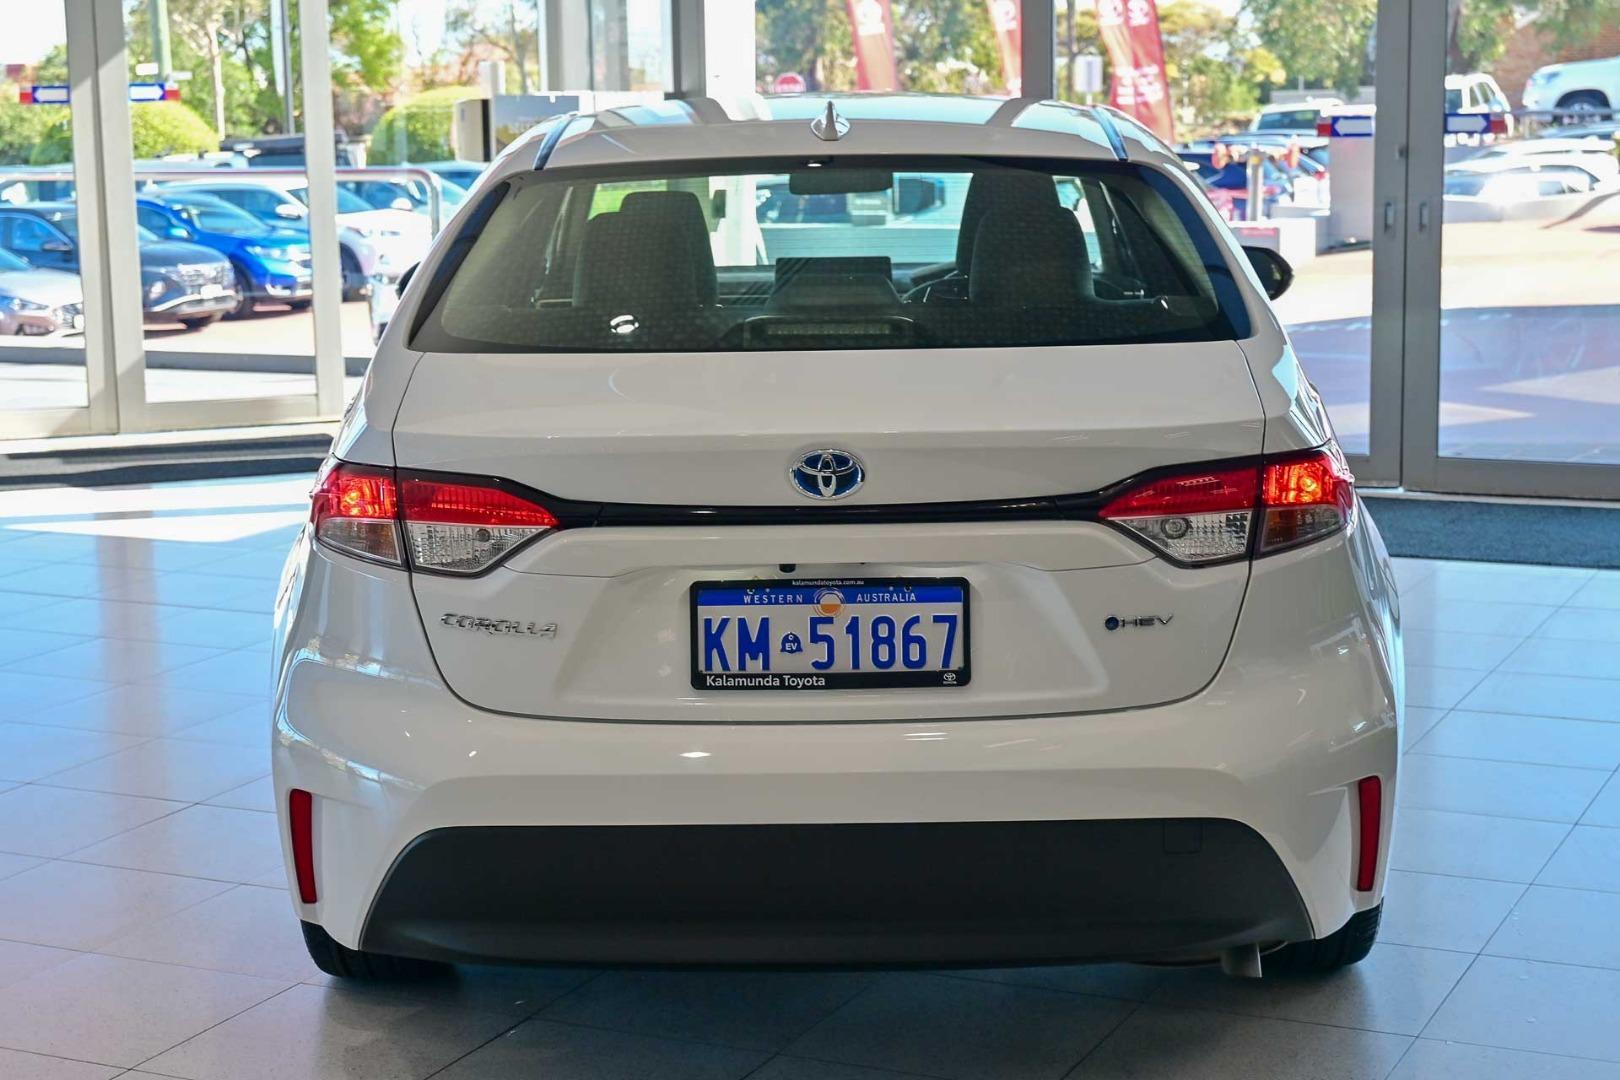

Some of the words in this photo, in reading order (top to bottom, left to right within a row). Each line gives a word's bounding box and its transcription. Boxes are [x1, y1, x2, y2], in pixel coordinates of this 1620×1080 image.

[743, 594, 804, 605] WESTERN
[856, 592, 918, 603] AUSTRALIA
[440, 613, 559, 639] COROLLA
[703, 616, 771, 672] KM
[809, 614, 959, 671] 51867
[705, 674, 781, 688] Kalamunda
[783, 674, 826, 688] Toyota
